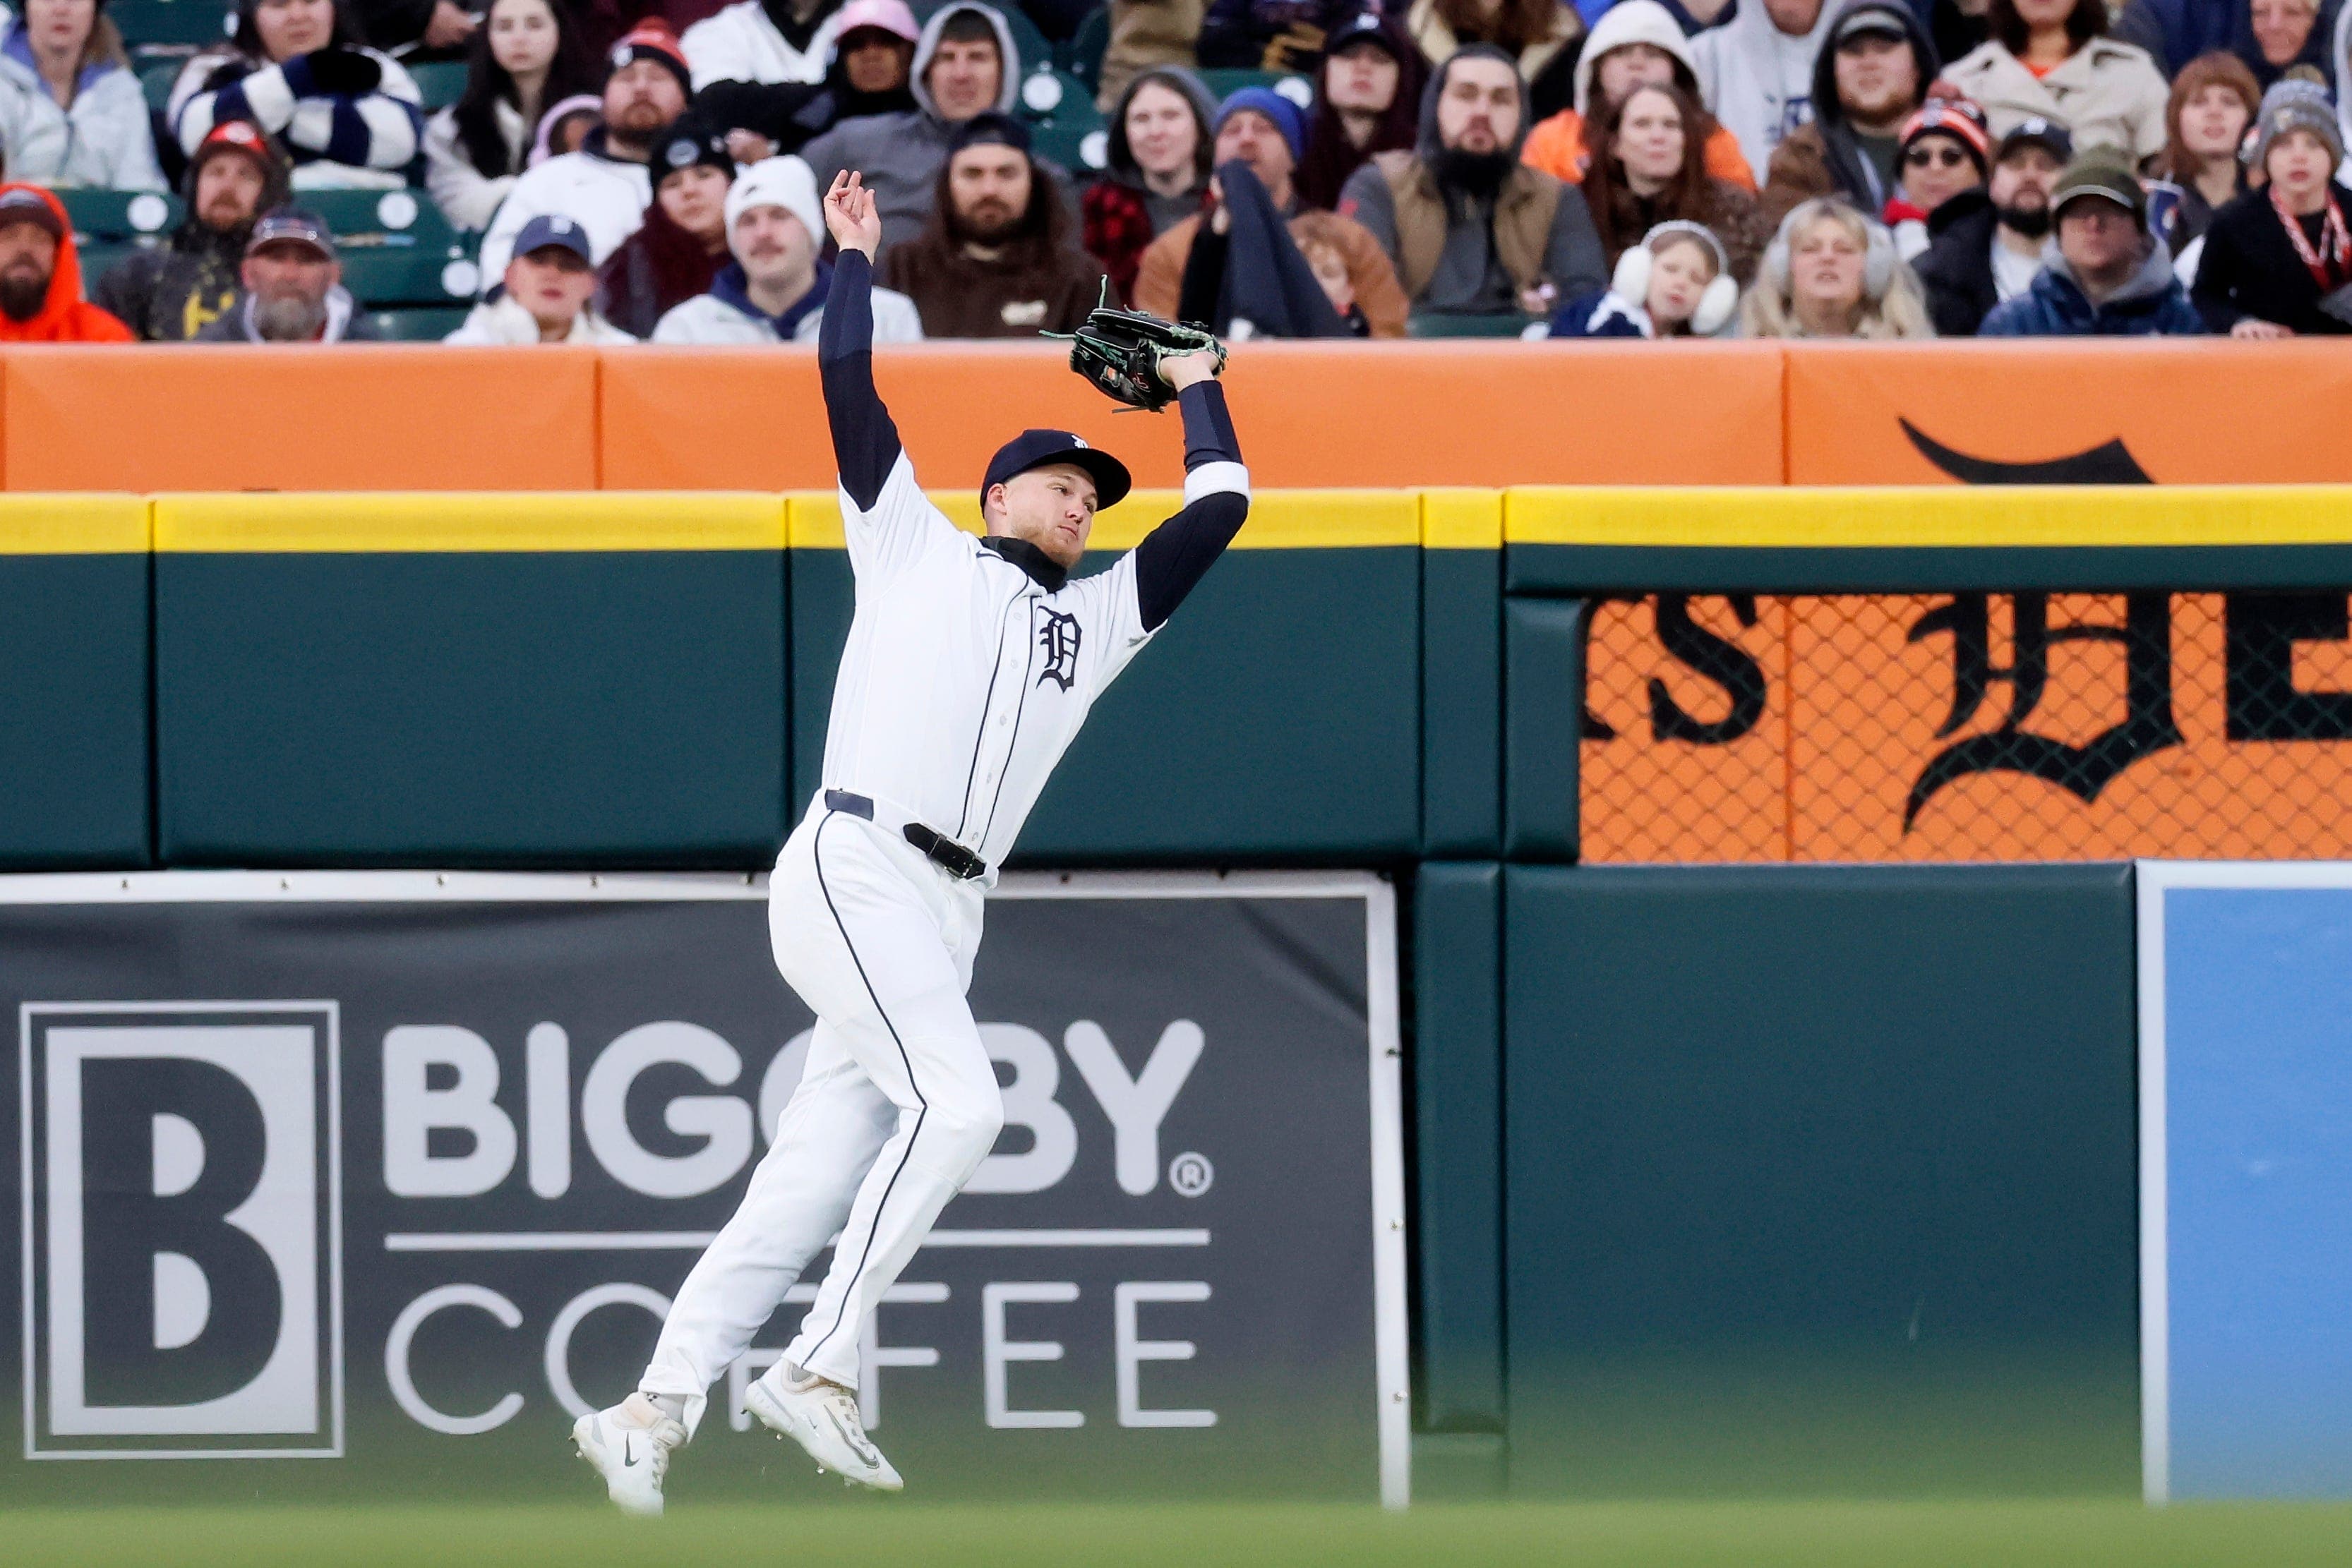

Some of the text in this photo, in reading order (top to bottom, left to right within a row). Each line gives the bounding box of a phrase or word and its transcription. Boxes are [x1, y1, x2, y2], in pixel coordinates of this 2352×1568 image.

[1036, 605, 1082, 694] D
[382, 1019, 1206, 1199] BIGBY
[81, 1056, 283, 1409] B
